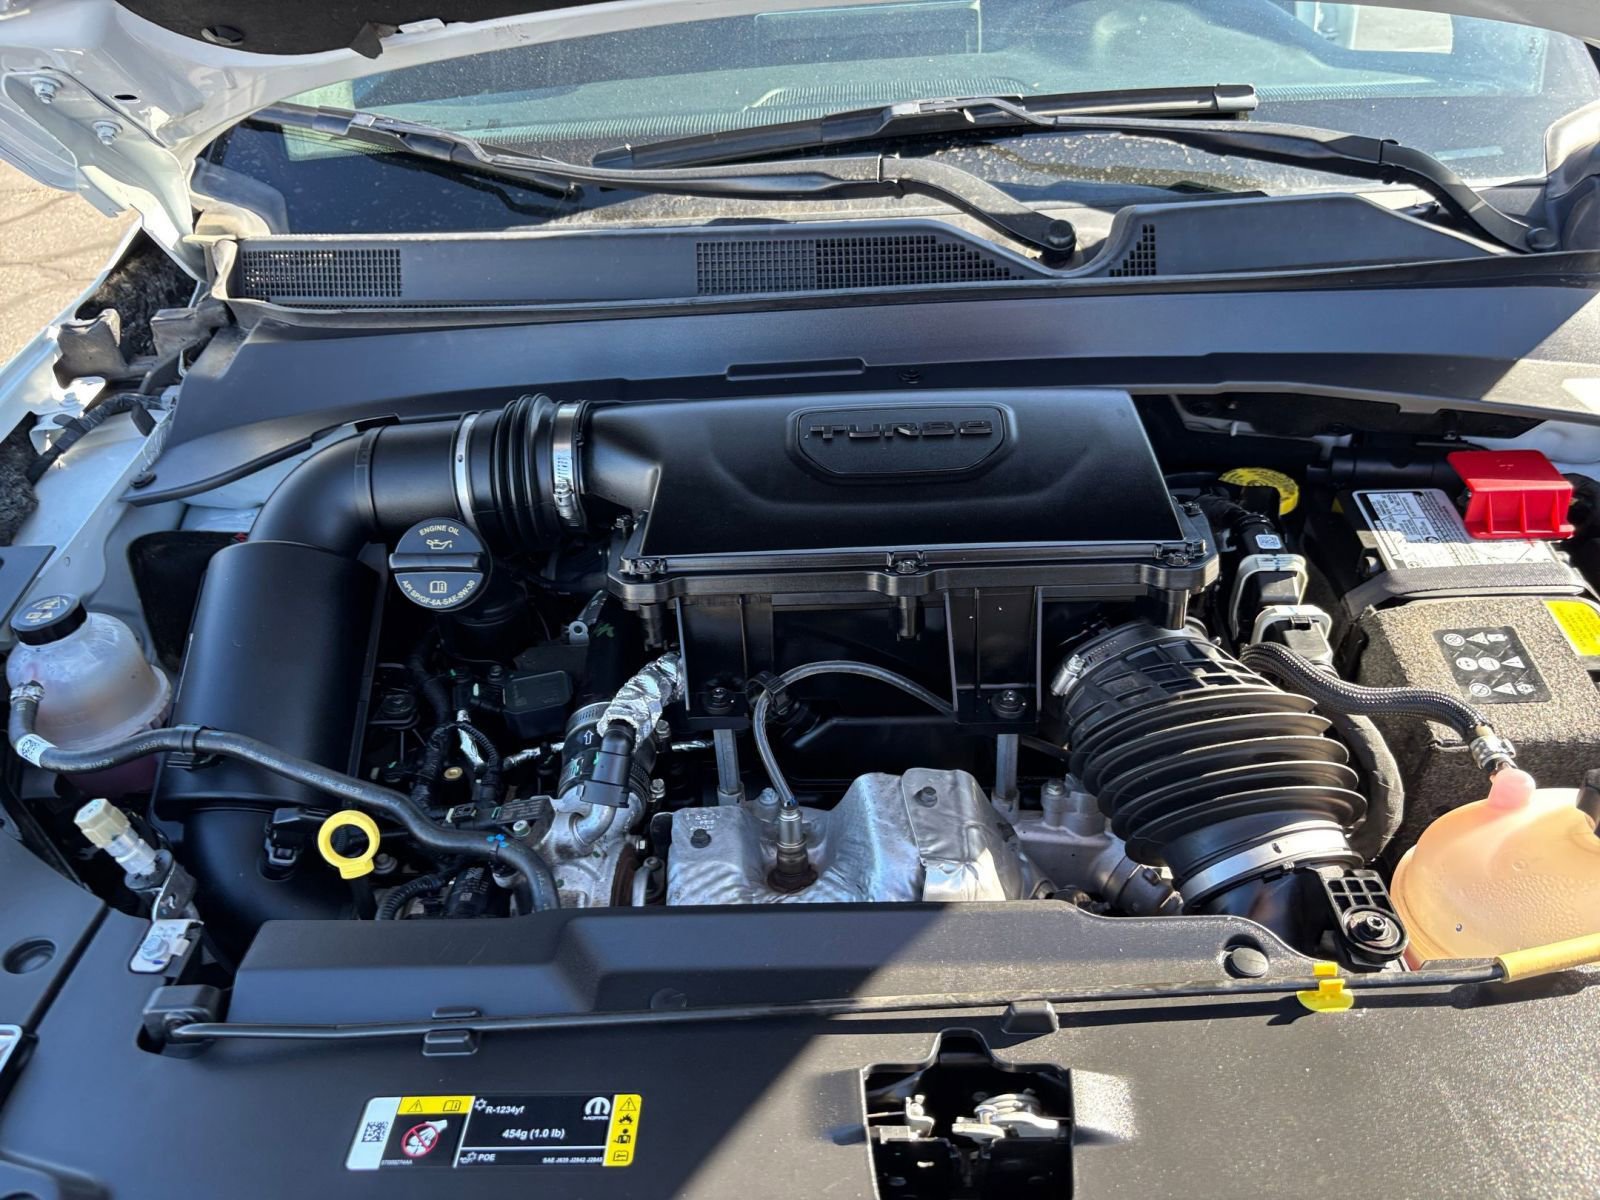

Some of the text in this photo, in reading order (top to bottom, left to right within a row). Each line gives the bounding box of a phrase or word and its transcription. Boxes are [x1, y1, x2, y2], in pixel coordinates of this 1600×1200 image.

[810, 420, 993, 440] TURBO
[418, 525, 460, 536] ENGINE OIL
[402, 580, 413, 592] API
[485, 1105, 526, 1115] R-1234yf
[502, 1128, 566, 1141] 454g (1.0 lb)
[478, 1153, 496, 1162] POE
